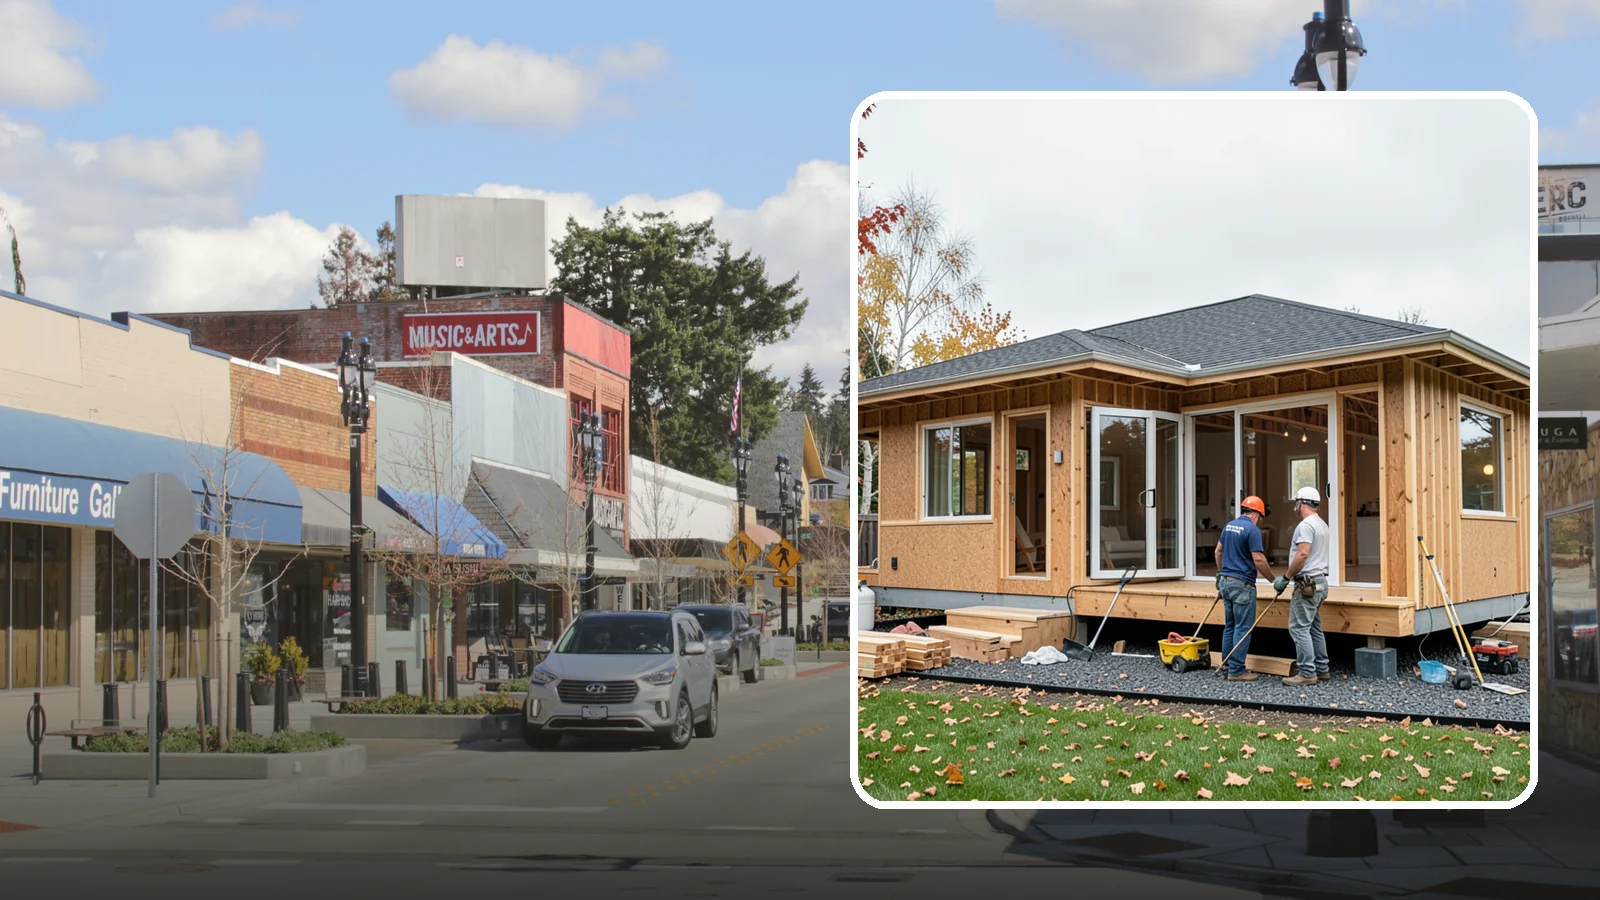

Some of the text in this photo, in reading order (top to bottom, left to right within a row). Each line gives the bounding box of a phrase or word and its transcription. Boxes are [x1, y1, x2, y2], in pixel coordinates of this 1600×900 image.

[409, 323, 519, 349] MUSIC&ARTS
[1540, 427, 1577, 436] UGA
[0, 471, 122, 519] Furniture Gal
[453, 563, 479, 574] SUSHI
